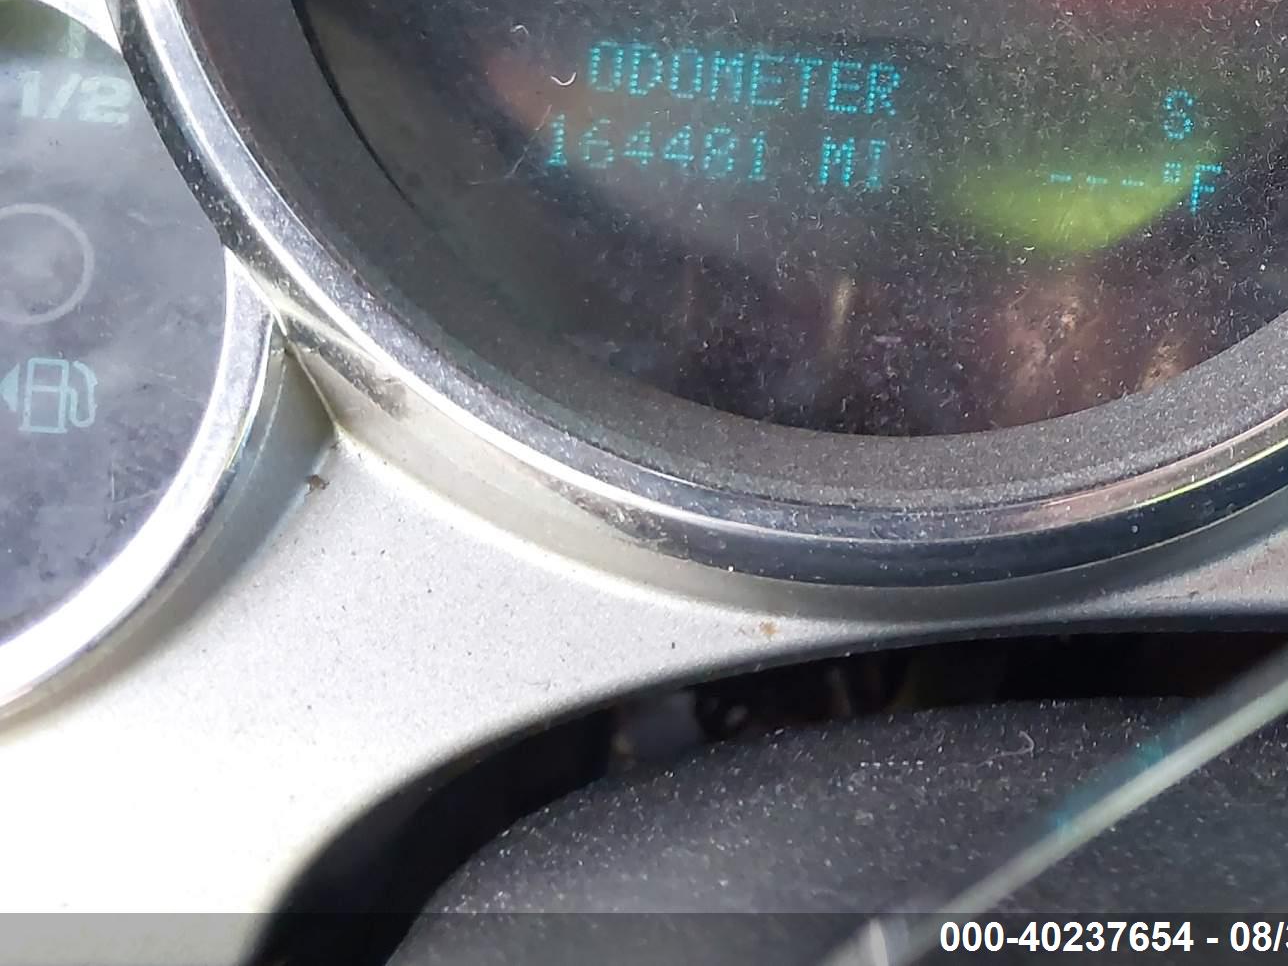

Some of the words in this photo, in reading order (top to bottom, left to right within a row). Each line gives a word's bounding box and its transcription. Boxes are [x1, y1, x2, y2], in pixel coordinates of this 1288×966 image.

[16, 69, 134, 125] 1/2
[585, 40, 903, 117] ODOMETER
[546, 113, 770, 183] 164481
[817, 134, 890, 190] MI
